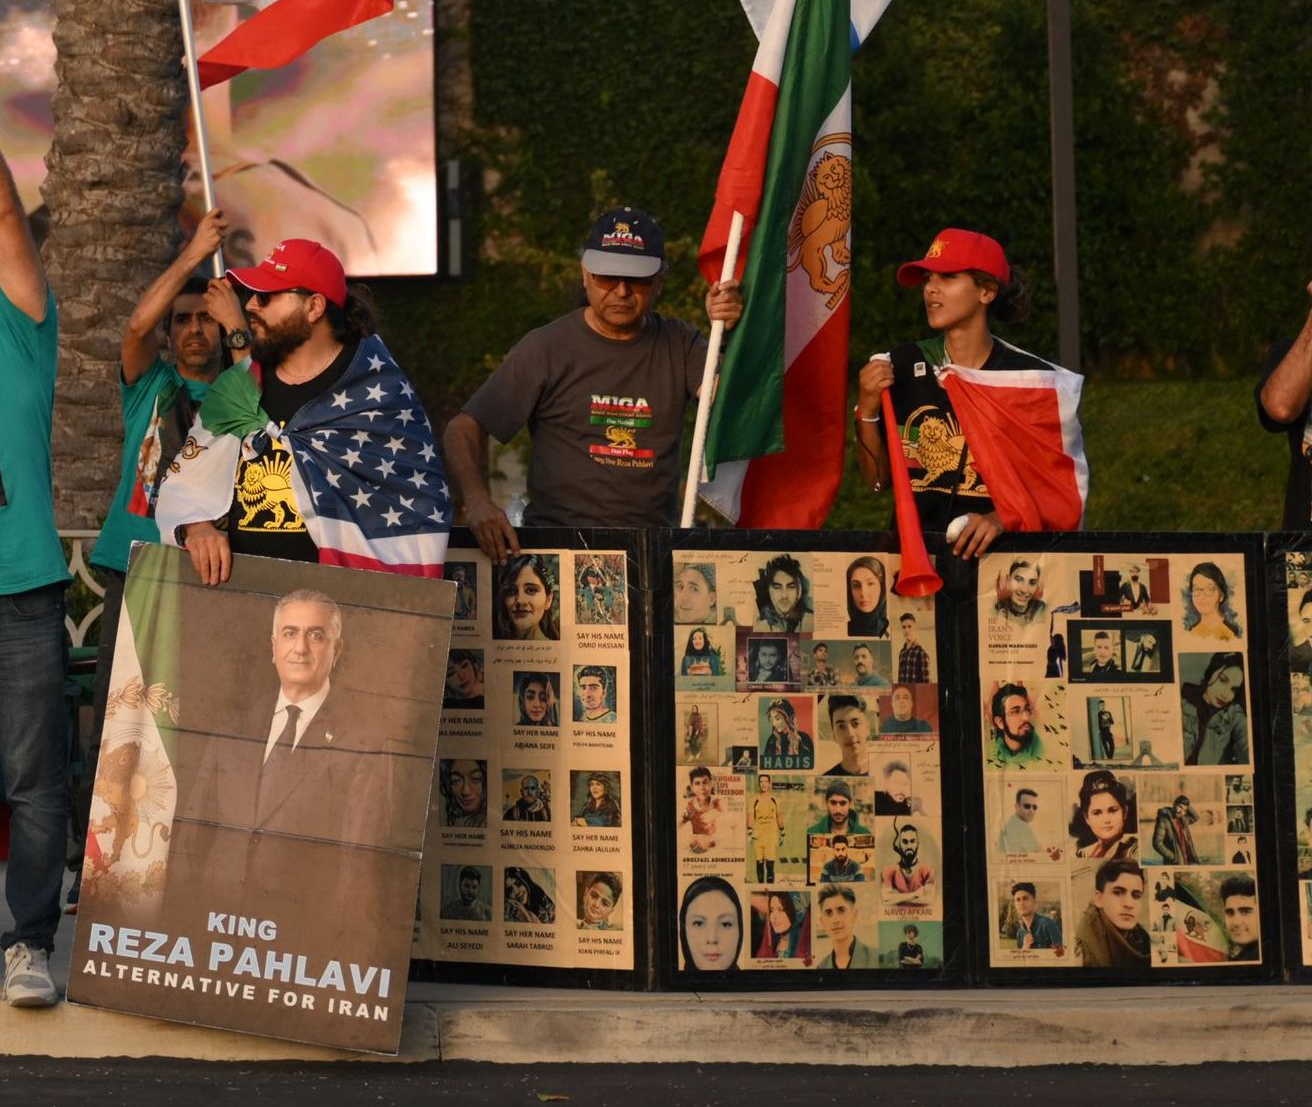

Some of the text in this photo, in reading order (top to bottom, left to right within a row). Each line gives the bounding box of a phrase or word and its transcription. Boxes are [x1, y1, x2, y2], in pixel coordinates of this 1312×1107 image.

[590, 395, 653, 413] MIGA
[577, 632, 625, 641] SAY HIS NAME
[526, 729, 539, 737] HER
[764, 757, 811, 769] HADIS
[500, 829, 552, 838] SAY HIS NAME
[207, 912, 277, 941] KING
[440, 927, 454, 935] SAY
[535, 931, 555, 939] NAME
[88, 922, 391, 998] REZA PAHLAVI
[83, 960, 389, 1021] ALTERNATIVE FOR IRAN
